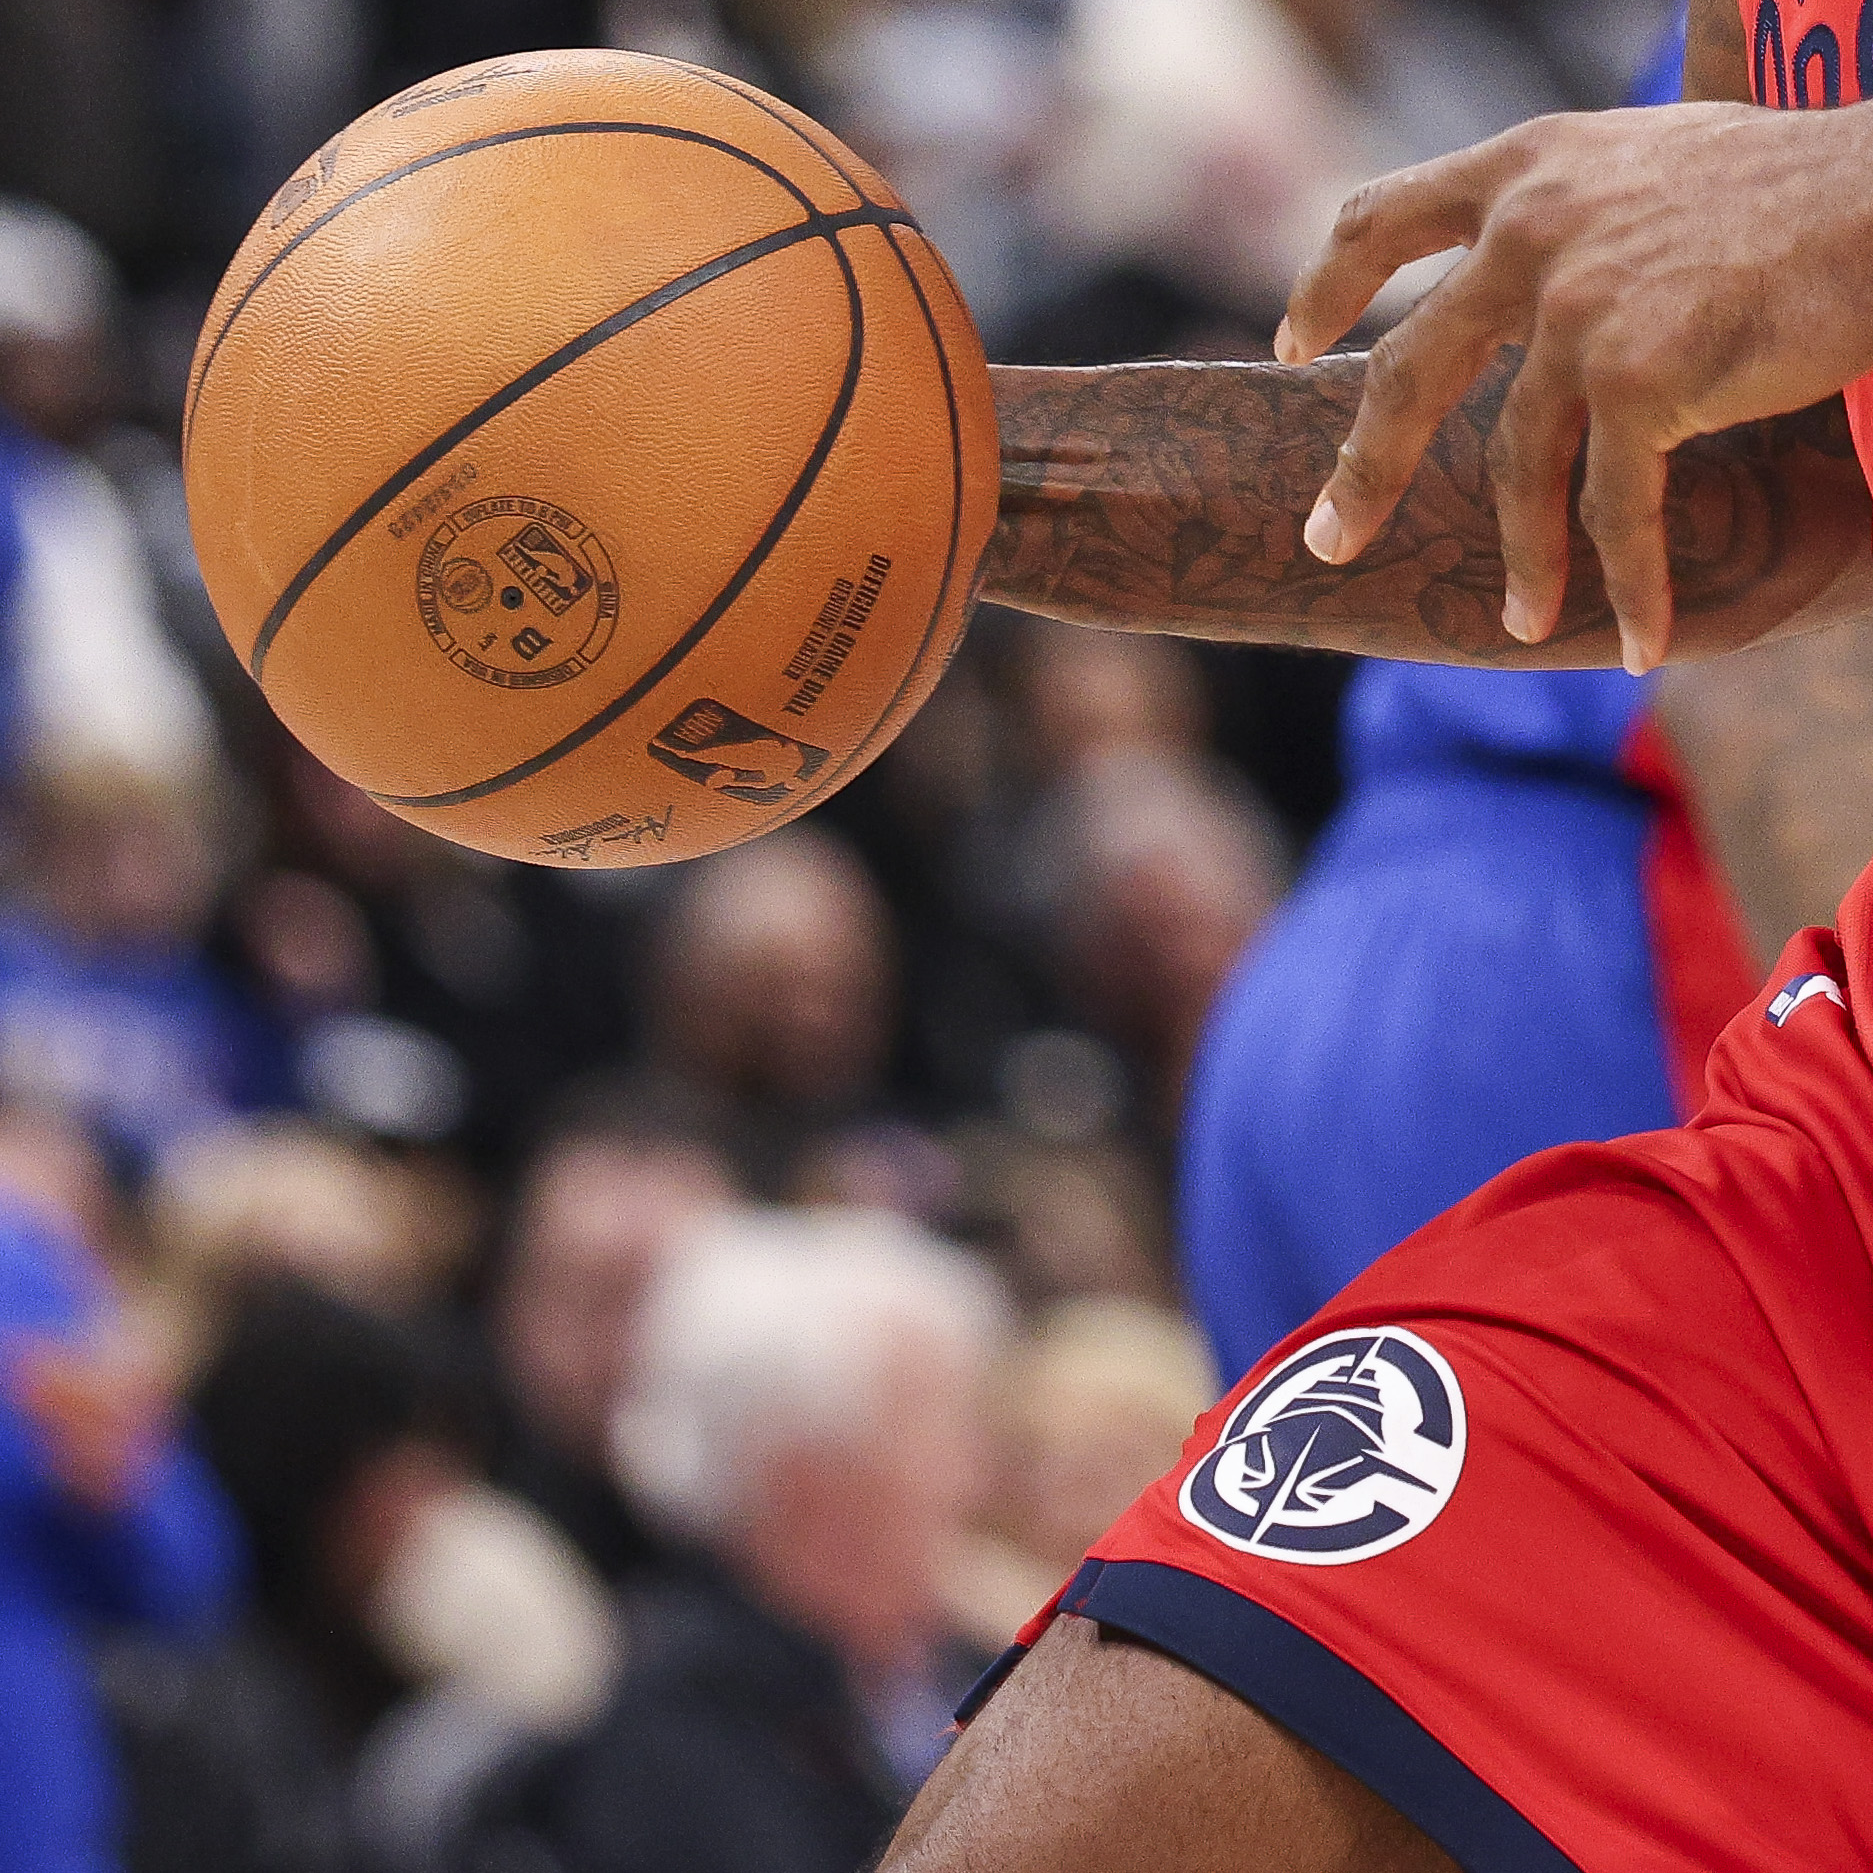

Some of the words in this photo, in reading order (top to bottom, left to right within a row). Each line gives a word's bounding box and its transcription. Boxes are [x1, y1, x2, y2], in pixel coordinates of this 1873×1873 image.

[842, 554, 891, 631] OFFICIAL
[812, 632, 856, 680] GAME
[781, 679, 825, 716] BALL
